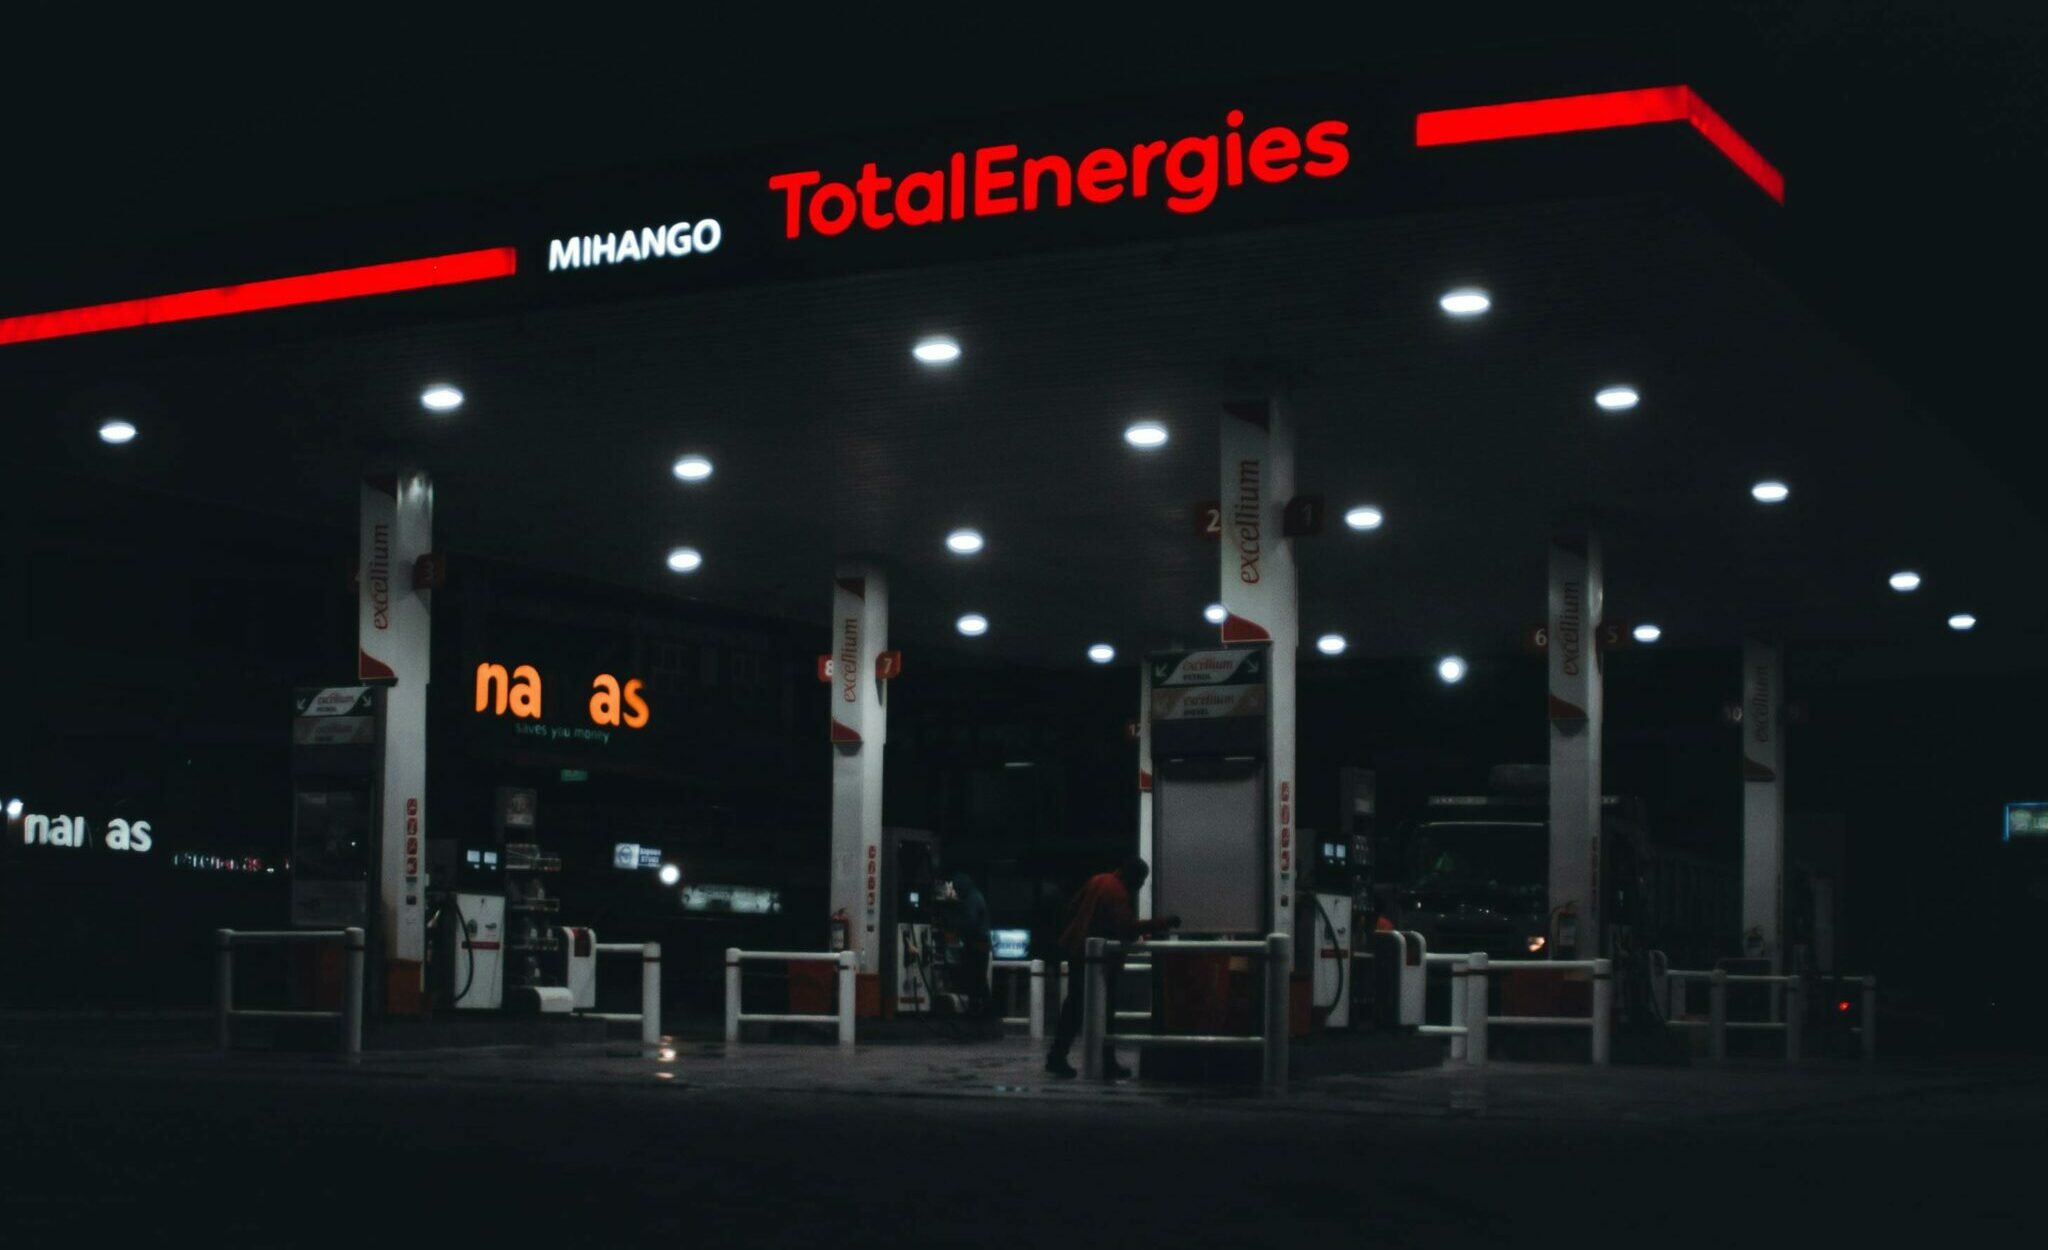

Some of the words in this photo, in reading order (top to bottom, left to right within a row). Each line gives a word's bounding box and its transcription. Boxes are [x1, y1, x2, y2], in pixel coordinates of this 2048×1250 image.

[769, 109, 1350, 240] TotalEnergies
[547, 218, 722, 272] MIHANGO
[1206, 509, 1221, 533] 2
[1235, 459, 1260, 584] excellium
[369, 523, 389, 630] excellium
[841, 618, 857, 703] excellium
[882, 657, 893, 674] 7
[1535, 628, 1548, 646] 6
[1559, 580, 1580, 676] excellium
